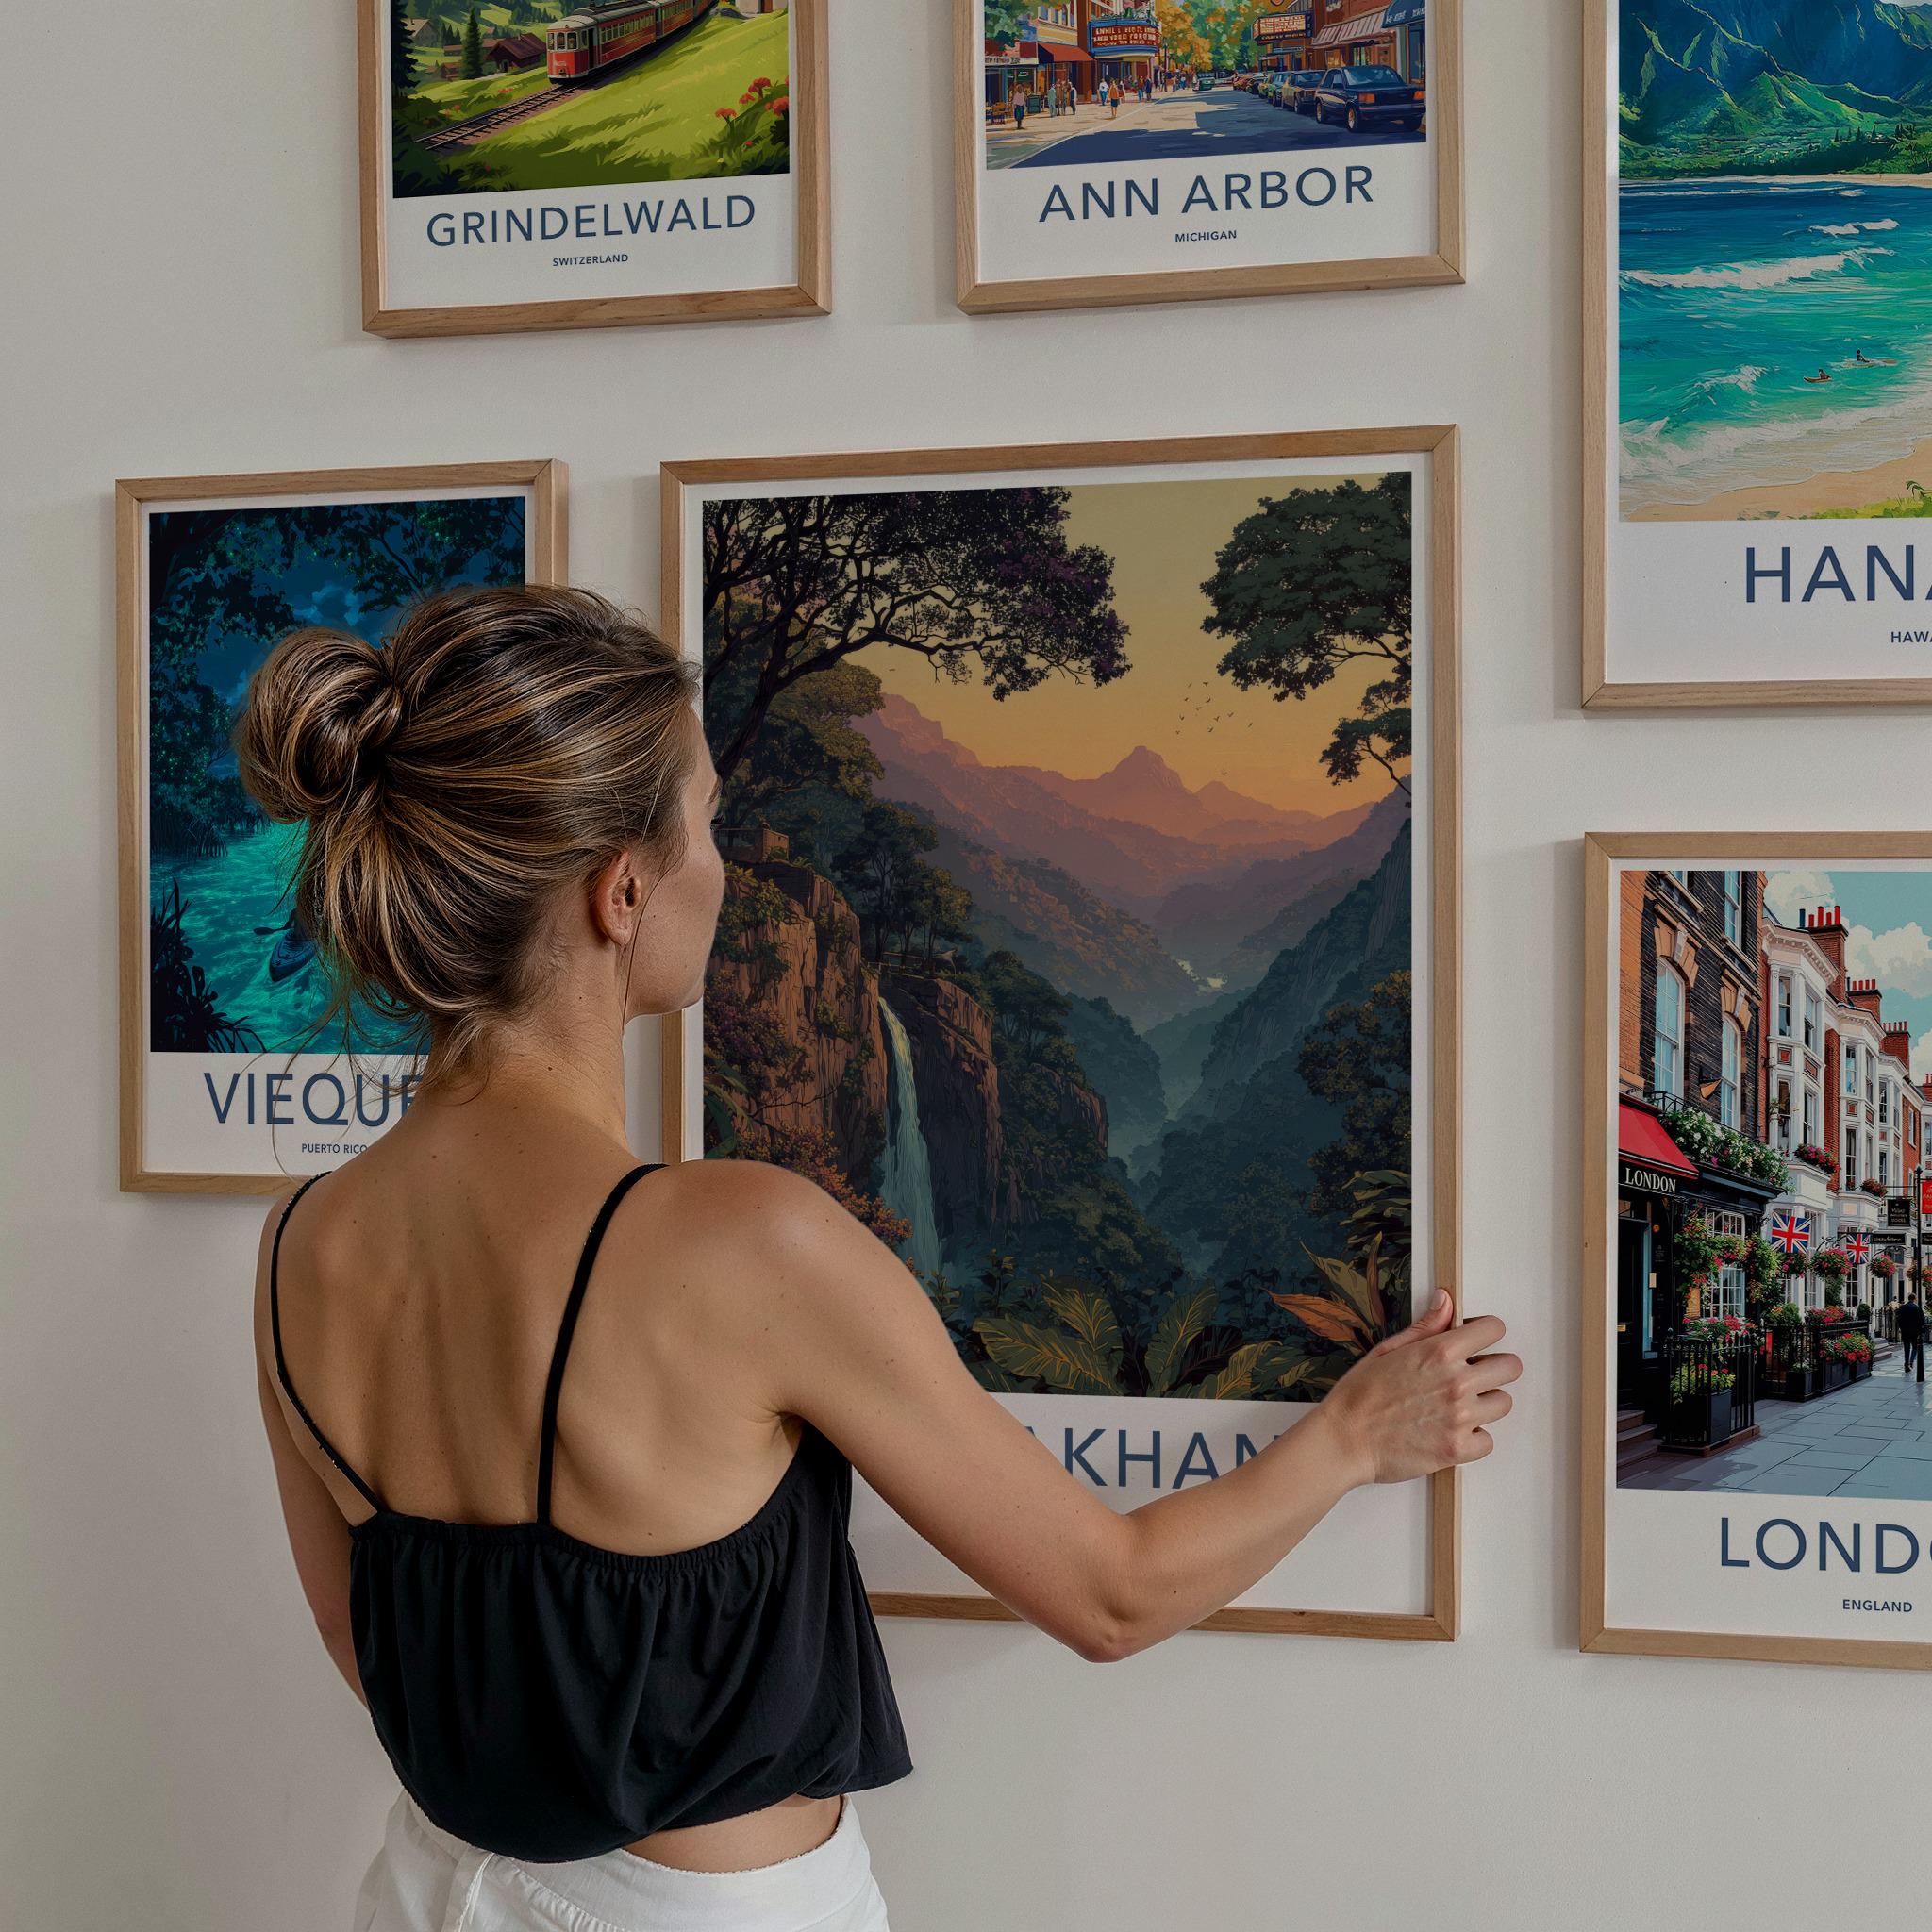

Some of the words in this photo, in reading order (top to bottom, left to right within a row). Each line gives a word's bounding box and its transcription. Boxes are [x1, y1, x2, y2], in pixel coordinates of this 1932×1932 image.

[1039, 177, 1158, 222] ANN
[1182, 165, 1374, 213] ARBOR
[426, 195, 756, 246] GRINDELWALD
[1174, 229, 1237, 242] MICHIGAN
[552, 254, 629, 267] SWITZERLAND
[1746, 545, 1932, 603] HAN
[1890, 631, 1932, 643] HAW
[301, 1143, 341, 1155] PUERTO
[343, 1144, 368, 1155] RICO
[1624, 1167, 1676, 1194] LONDON
[1721, 1517, 1932, 1574] LOND
[1842, 1599, 1913, 1613] ENGLAND
